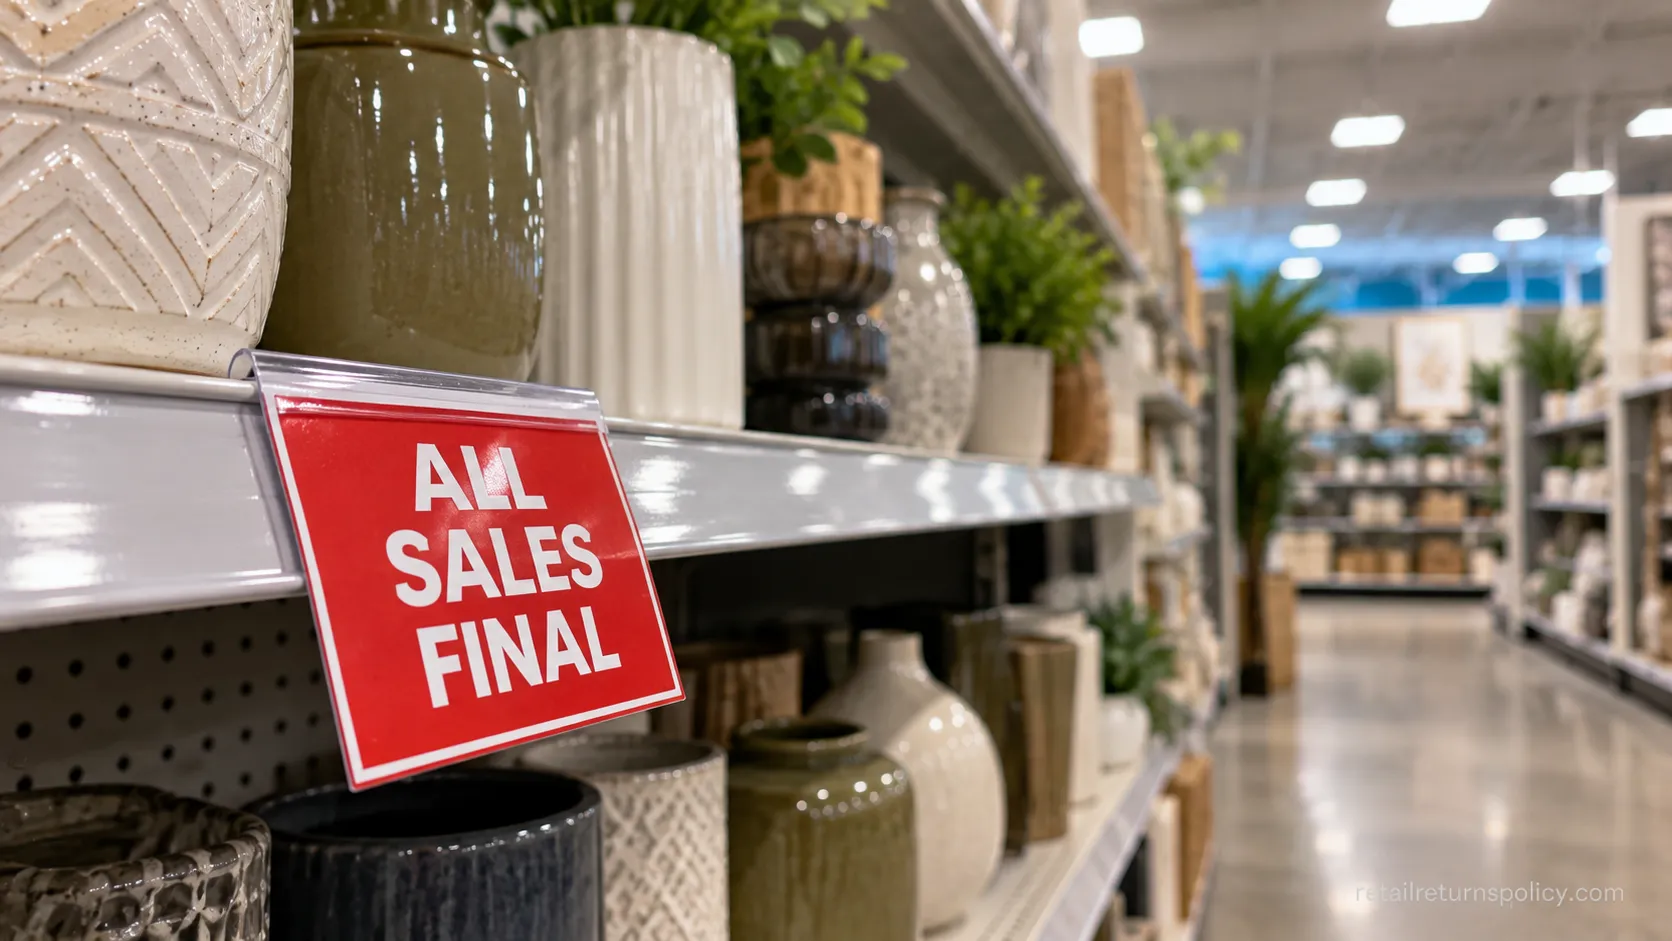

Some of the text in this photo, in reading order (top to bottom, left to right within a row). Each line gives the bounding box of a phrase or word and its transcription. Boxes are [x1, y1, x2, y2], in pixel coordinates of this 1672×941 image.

[414, 442, 548, 512] ALL
[385, 523, 603, 608] SALES
[416, 605, 622, 709] FINAL
